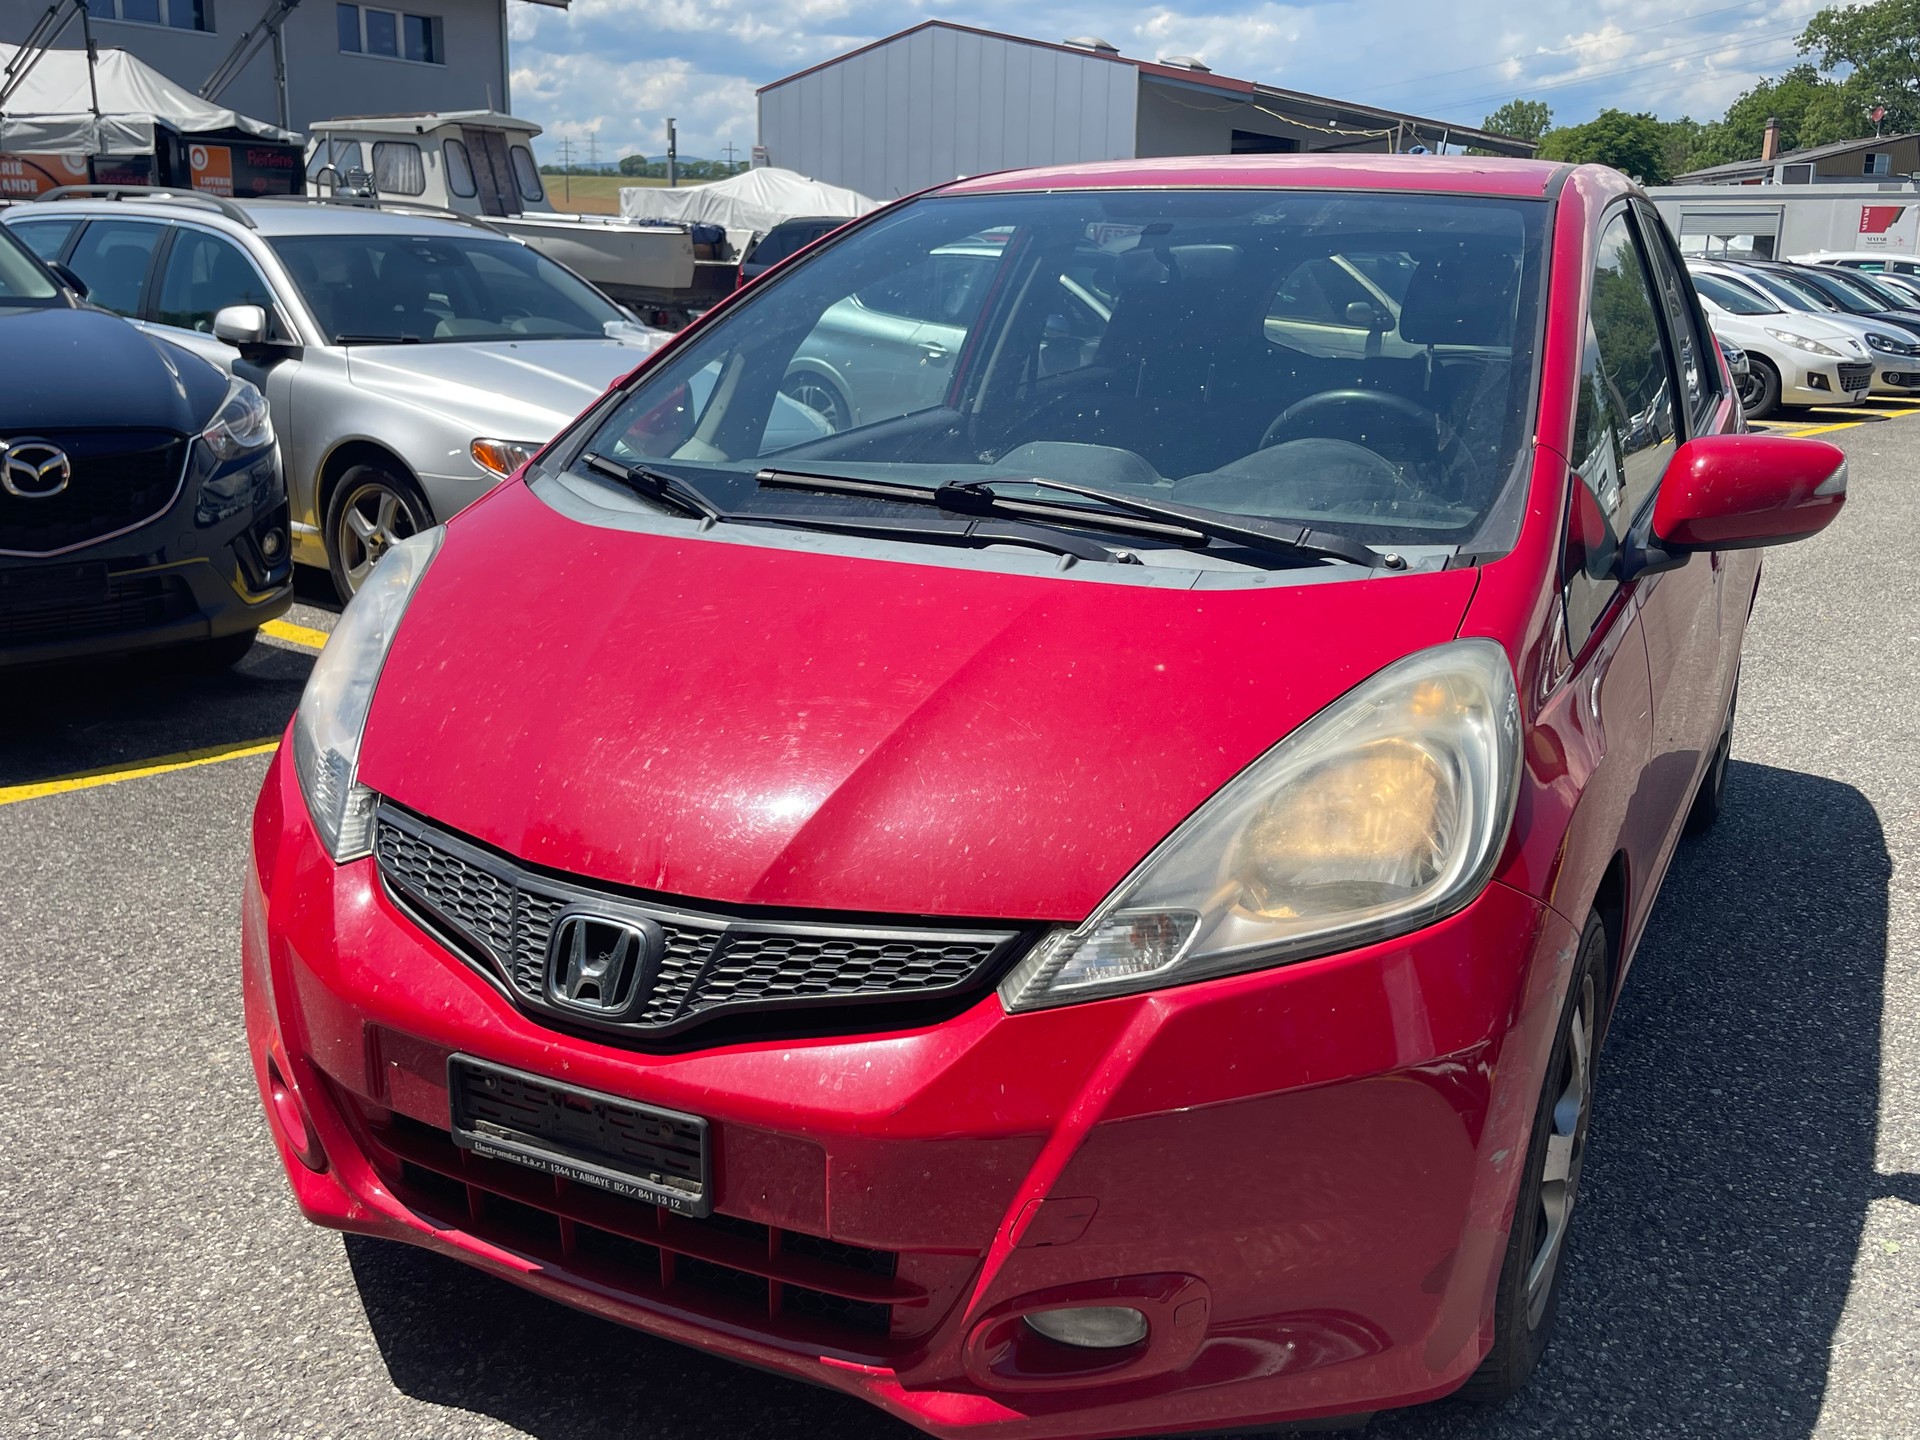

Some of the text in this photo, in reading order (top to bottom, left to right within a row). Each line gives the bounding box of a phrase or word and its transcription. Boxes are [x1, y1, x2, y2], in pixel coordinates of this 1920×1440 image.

[0, 162, 23, 175] RIE
[0, 179, 38, 192] ANDE
[550, 1163, 570, 1176] 1344
[572, 1169, 610, 1187] L'ABBAYE
[671, 1198, 681, 1209] 12
